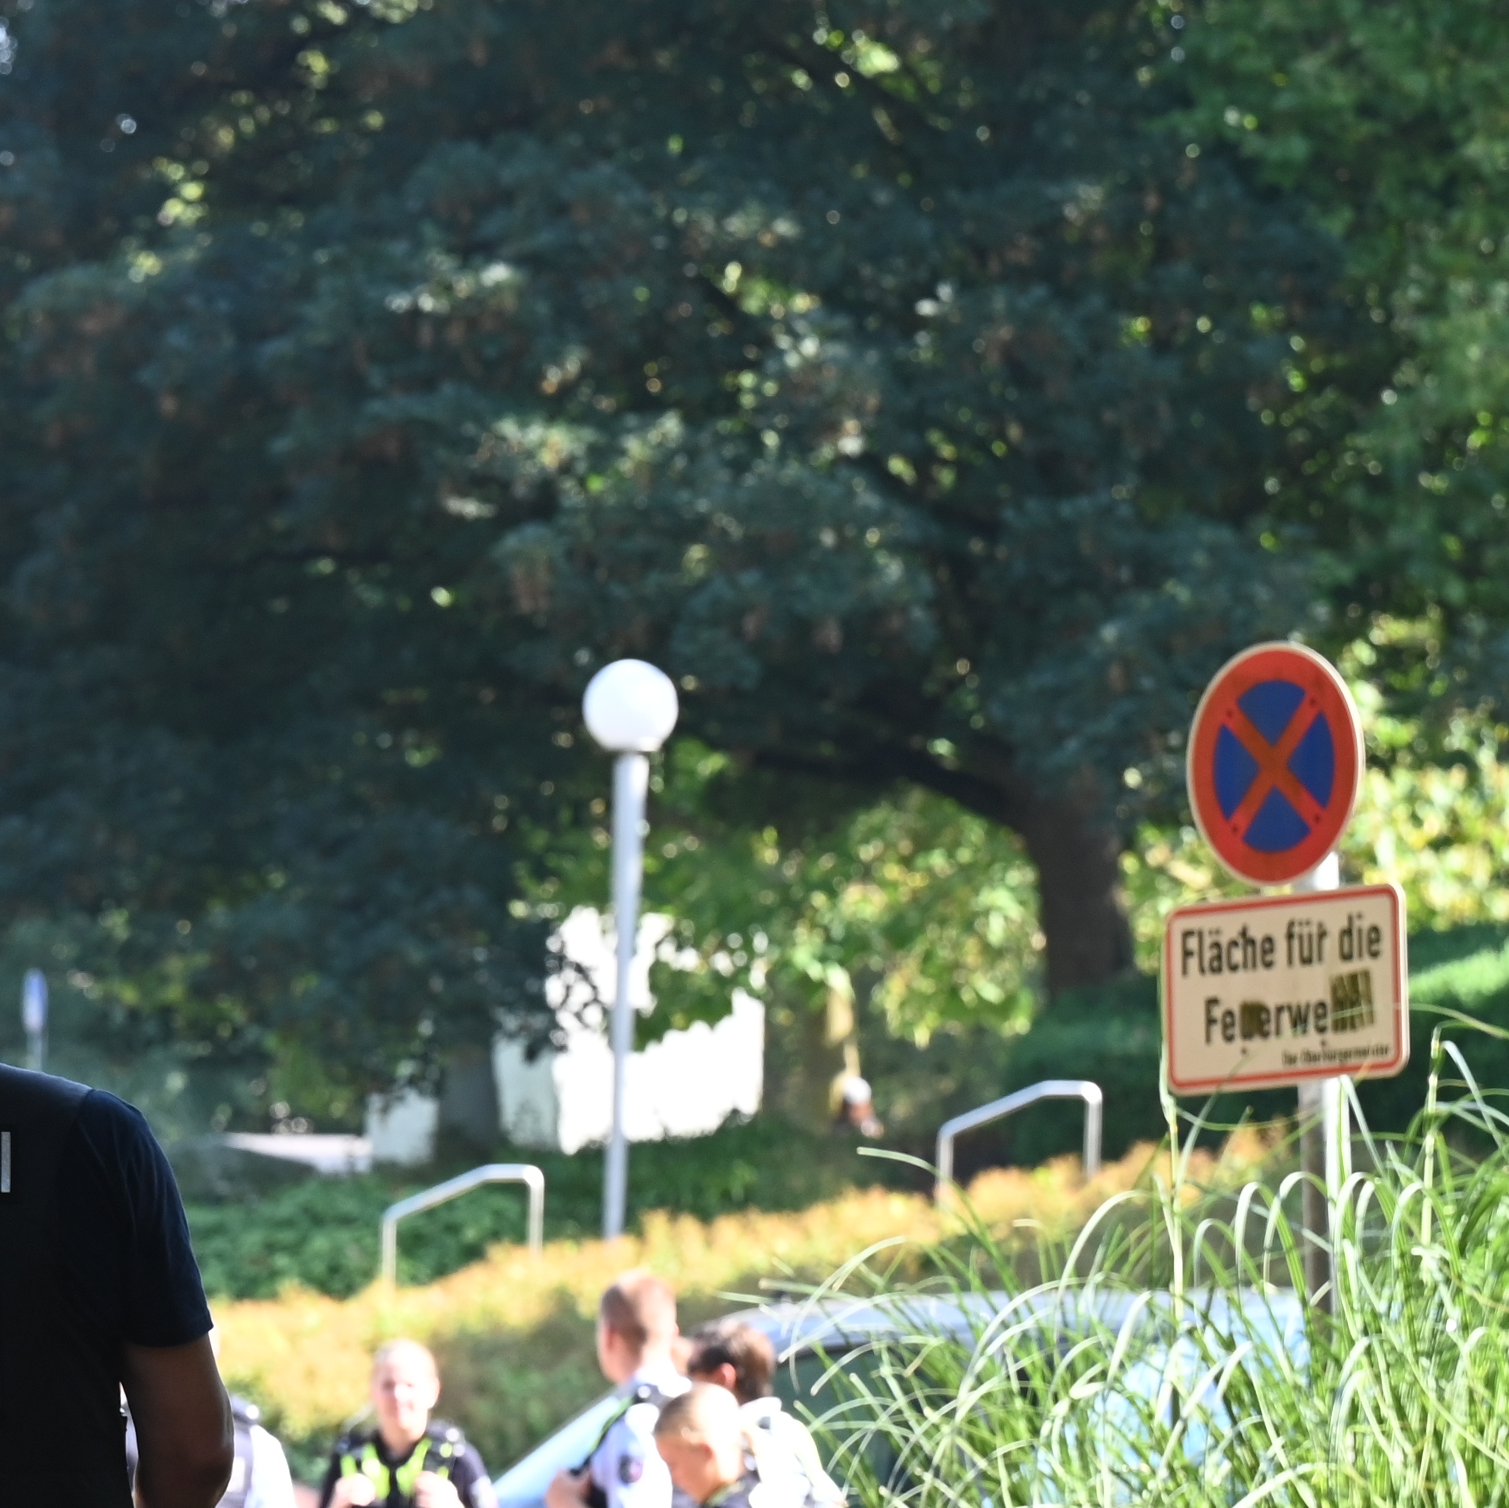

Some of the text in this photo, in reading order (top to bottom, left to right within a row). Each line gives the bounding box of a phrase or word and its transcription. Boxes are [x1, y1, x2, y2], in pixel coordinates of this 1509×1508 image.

[1181, 915, 1383, 977] Fläche für die
